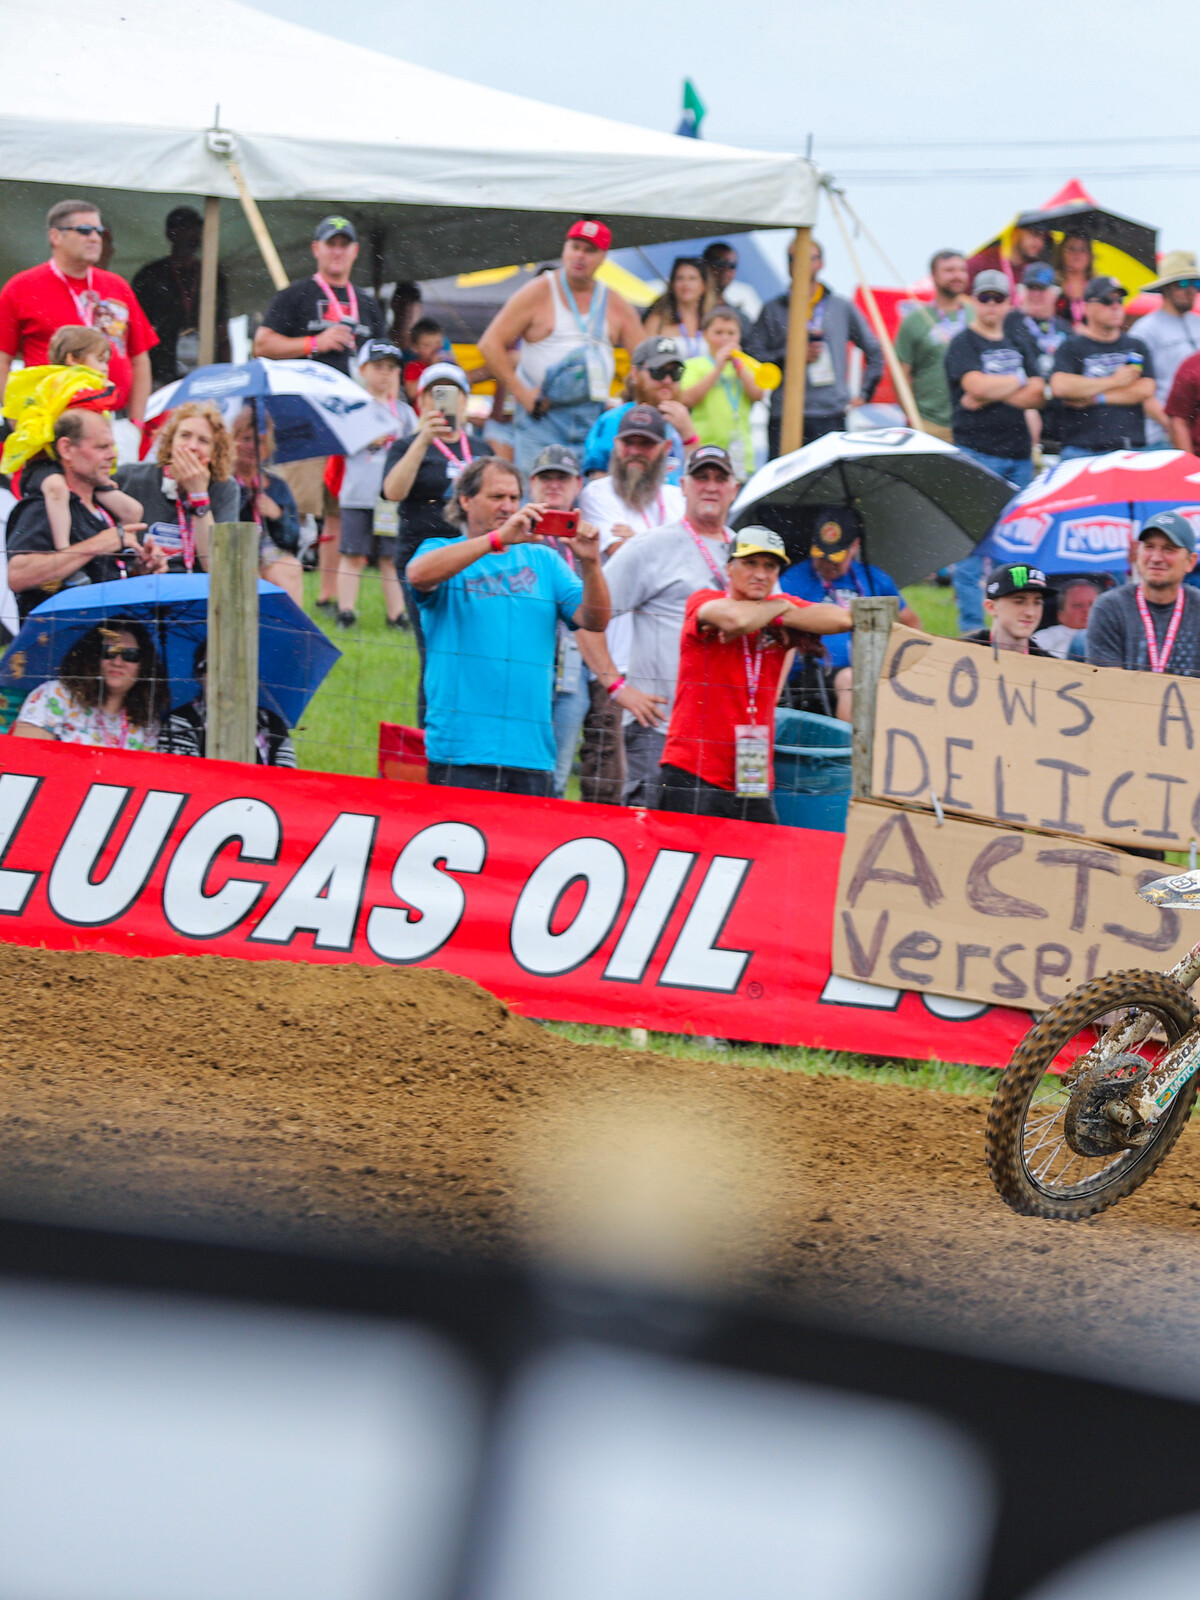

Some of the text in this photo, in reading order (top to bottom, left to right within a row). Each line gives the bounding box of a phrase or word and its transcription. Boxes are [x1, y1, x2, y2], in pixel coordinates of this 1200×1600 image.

[888, 638, 1094, 738] COWS
[509, 836, 756, 996] OIL
[846, 812, 1182, 954] ACTS
[842, 910, 1072, 1005] Verse
